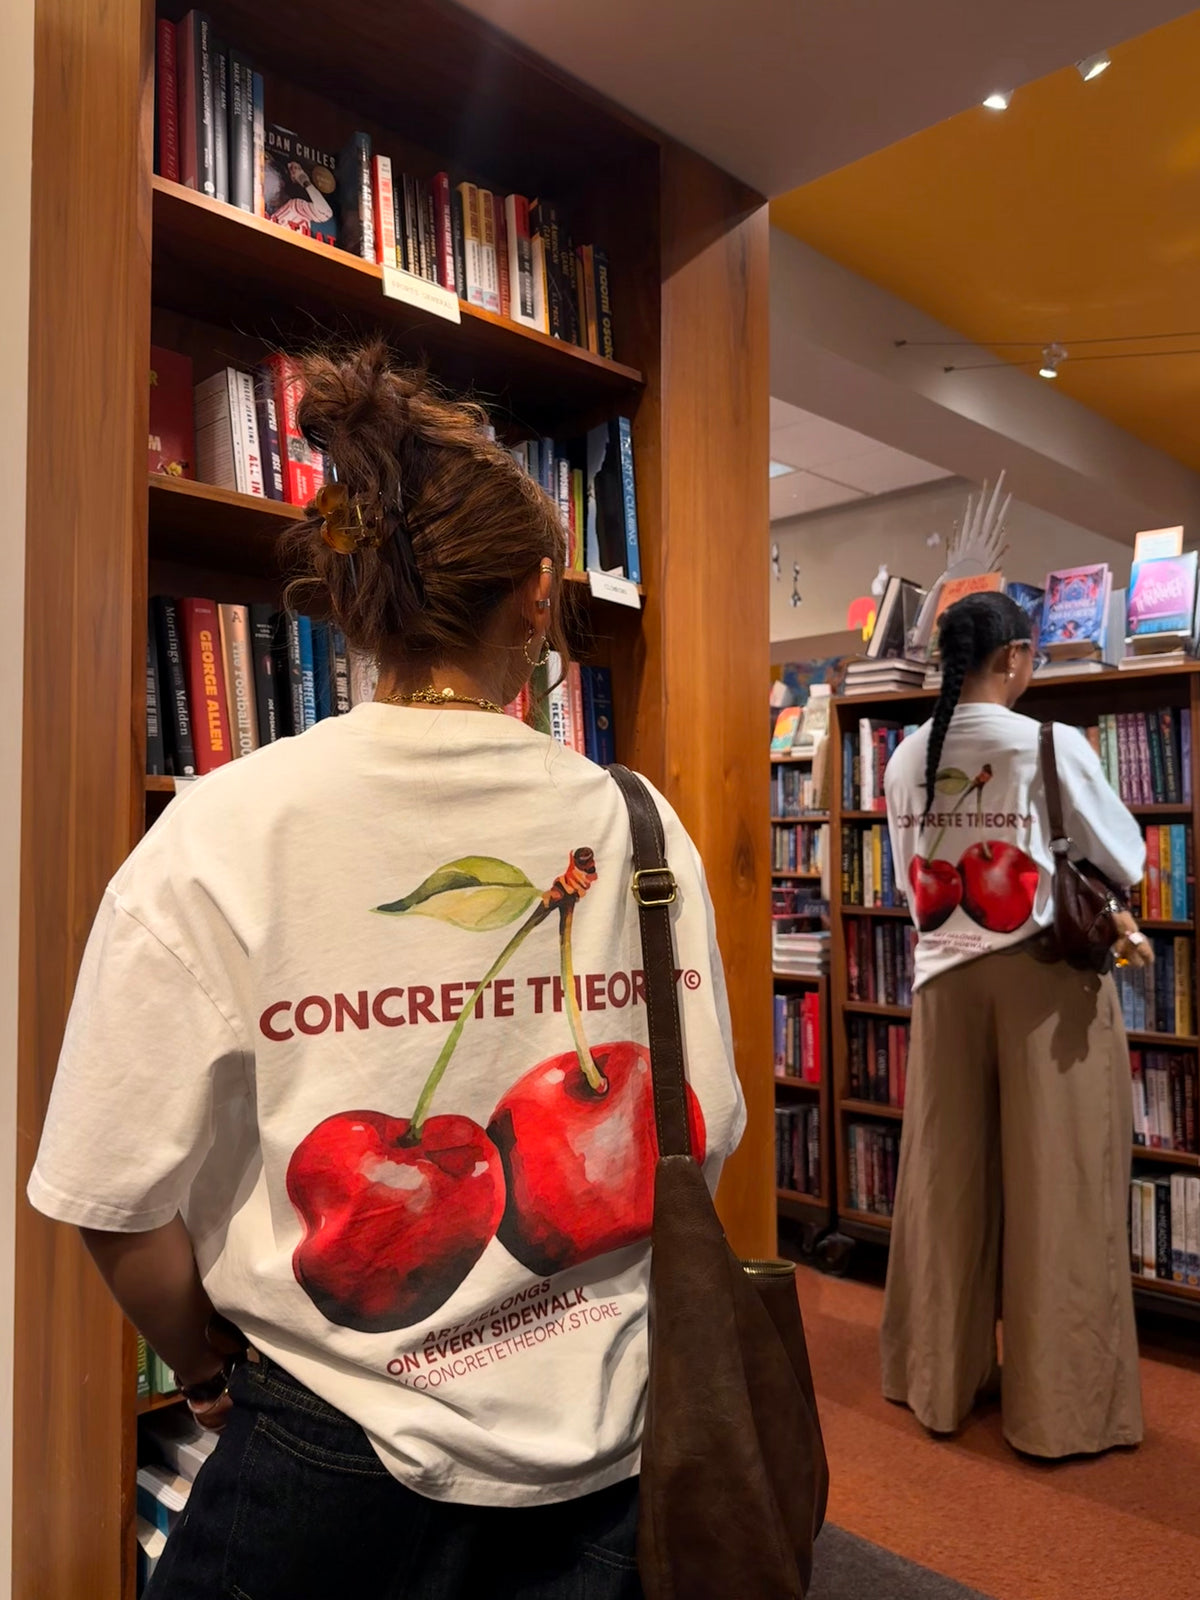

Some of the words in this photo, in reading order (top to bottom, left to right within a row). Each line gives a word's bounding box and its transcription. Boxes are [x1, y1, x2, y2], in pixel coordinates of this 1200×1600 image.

[296, 143, 336, 170] CHILES
[362, 168, 370, 184] THE
[362, 186, 372, 208] ART
[363, 221, 374, 262] CYCLIN
[599, 265, 612, 315] naomi
[247, 426, 255, 444] KING
[248, 454, 259, 475] ALL
[624, 459, 632, 477] ART
[251, 481, 260, 494] IN
[625, 478, 634, 493] OF
[560, 501, 569, 511] TO
[626, 496, 637, 546] CLIMBING
[164, 606, 180, 663] Mornings
[200, 630, 218, 696] GEORGE
[232, 640, 243, 667] The
[336, 657, 346, 674] THE
[174, 666, 182, 686] with
[302, 670, 314, 707] PERFECT
[337, 677, 347, 697] WHY
[235, 670, 250, 728] Football
[175, 690, 189, 736] Madden
[207, 700, 224, 751] ALLEN
[304, 709, 316, 730] ELO
[552, 703, 560, 742] REBE
[238, 731, 252, 757] 100
[898, 812, 963, 829] CONRETE
[258, 978, 515, 1042] CONCRETE
[386, 1350, 421, 1376] ON
[425, 1326, 487, 1364] EVERY
[492, 1286, 589, 1338] SIDEWALK
[422, 1322, 464, 1346] ART
